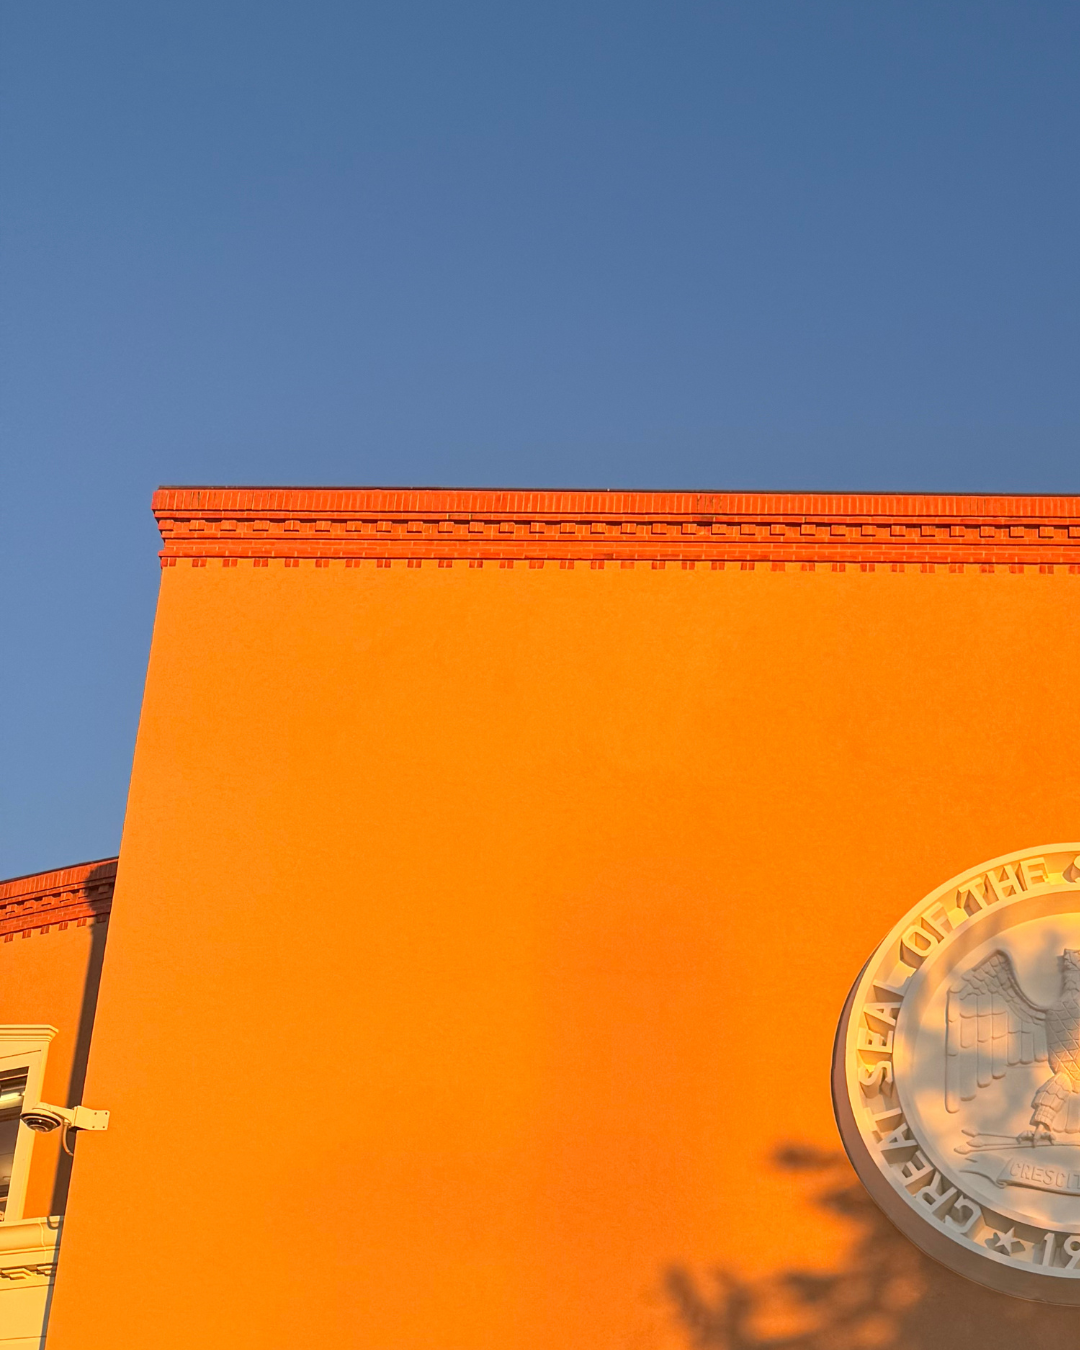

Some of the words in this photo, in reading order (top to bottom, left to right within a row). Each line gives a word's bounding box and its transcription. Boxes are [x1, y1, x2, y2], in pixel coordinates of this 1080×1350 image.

[957, 857, 1049, 906] THE
[902, 901, 950, 957] OF
[858, 976, 912, 1086] SEAL
[864, 1107, 982, 1234] GREAT
